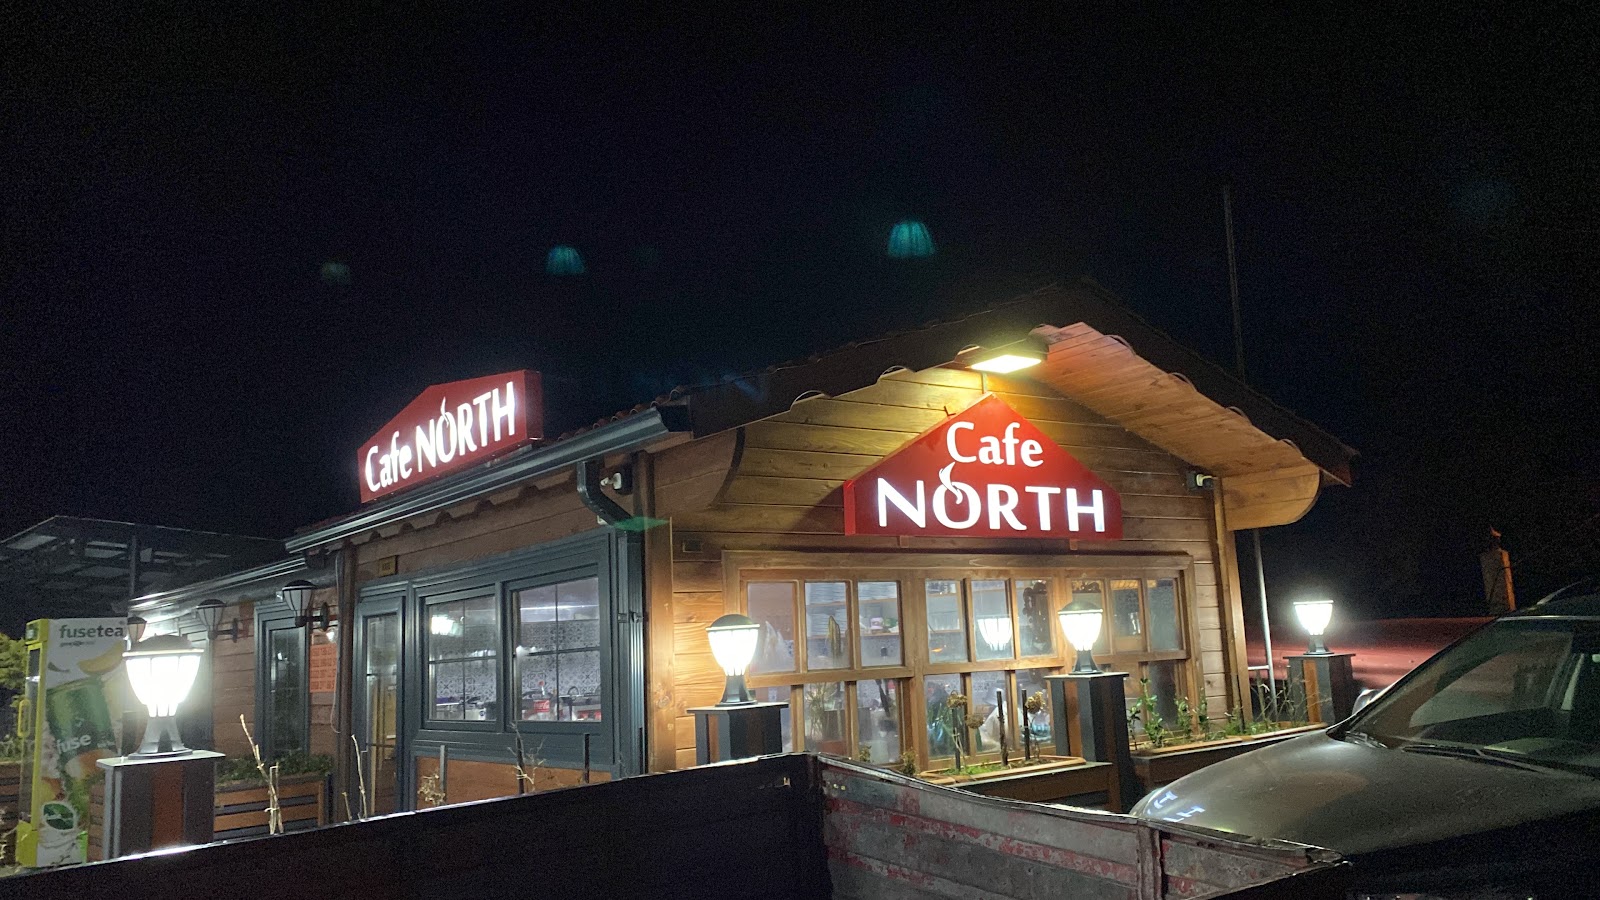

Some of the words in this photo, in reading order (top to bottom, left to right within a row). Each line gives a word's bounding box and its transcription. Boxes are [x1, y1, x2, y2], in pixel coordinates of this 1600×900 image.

[365, 431, 412, 492] Cafe
[416, 381, 515, 473] NORTH
[946, 421, 1044, 467] Cafe
[877, 475, 1105, 532] NORTH
[59, 624, 124, 639] fusetea
